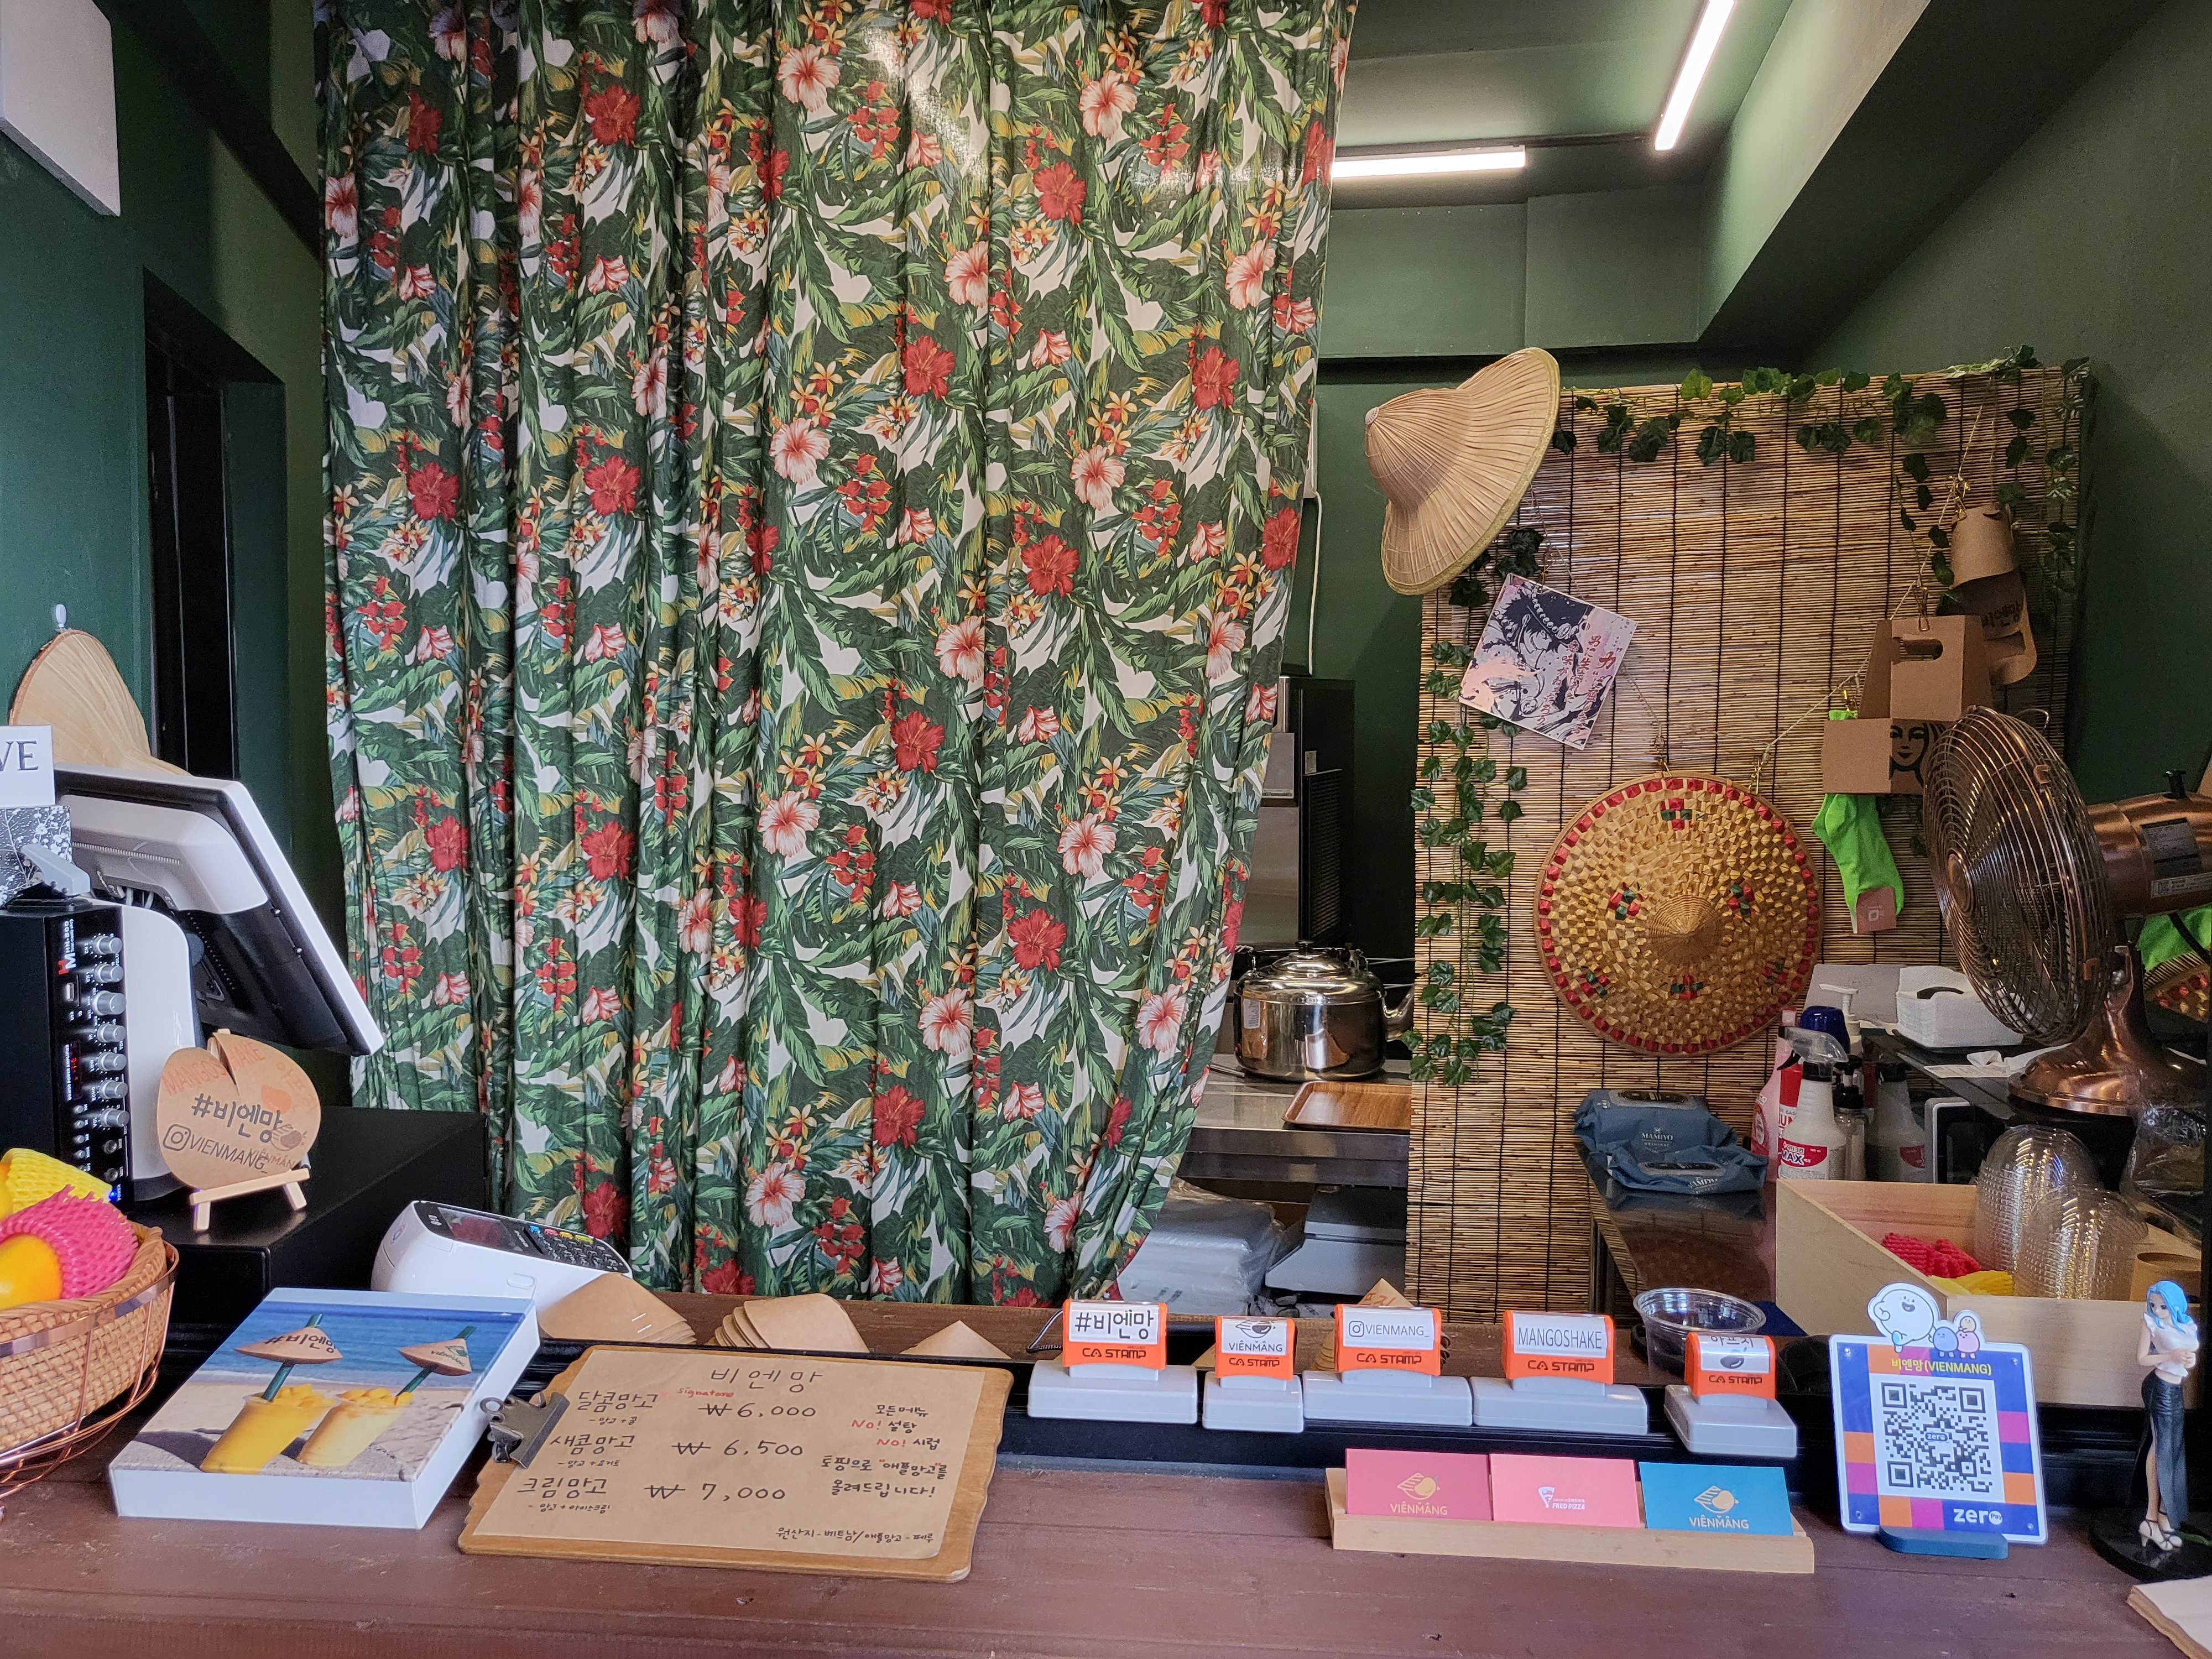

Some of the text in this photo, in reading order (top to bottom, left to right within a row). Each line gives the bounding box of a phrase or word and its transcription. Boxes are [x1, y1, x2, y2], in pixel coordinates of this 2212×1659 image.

[191, 1092, 283, 1143] #비엔망
[1074, 1309, 1154, 1340] #비엔망
[1518, 1327, 1603, 1349] MANGOSHAKE
[1105, 1348, 1146, 1359] STAMP
[1380, 1354, 1422, 1364] STAMP
[1247, 1359, 1280, 1367] STAMP
[1552, 1361, 1595, 1373] STAMP
[1728, 1376, 1762, 1385] STAMP
[577, 1390, 659, 1413] 달콤망고
[888, 1420, 917, 1434] 설탕
[550, 1434, 635, 1455] 새콤망고
[913, 1438, 941, 1450] 시럽
[821, 1455, 873, 1472] 토핑으로
[518, 1478, 607, 1499] 크림망고
